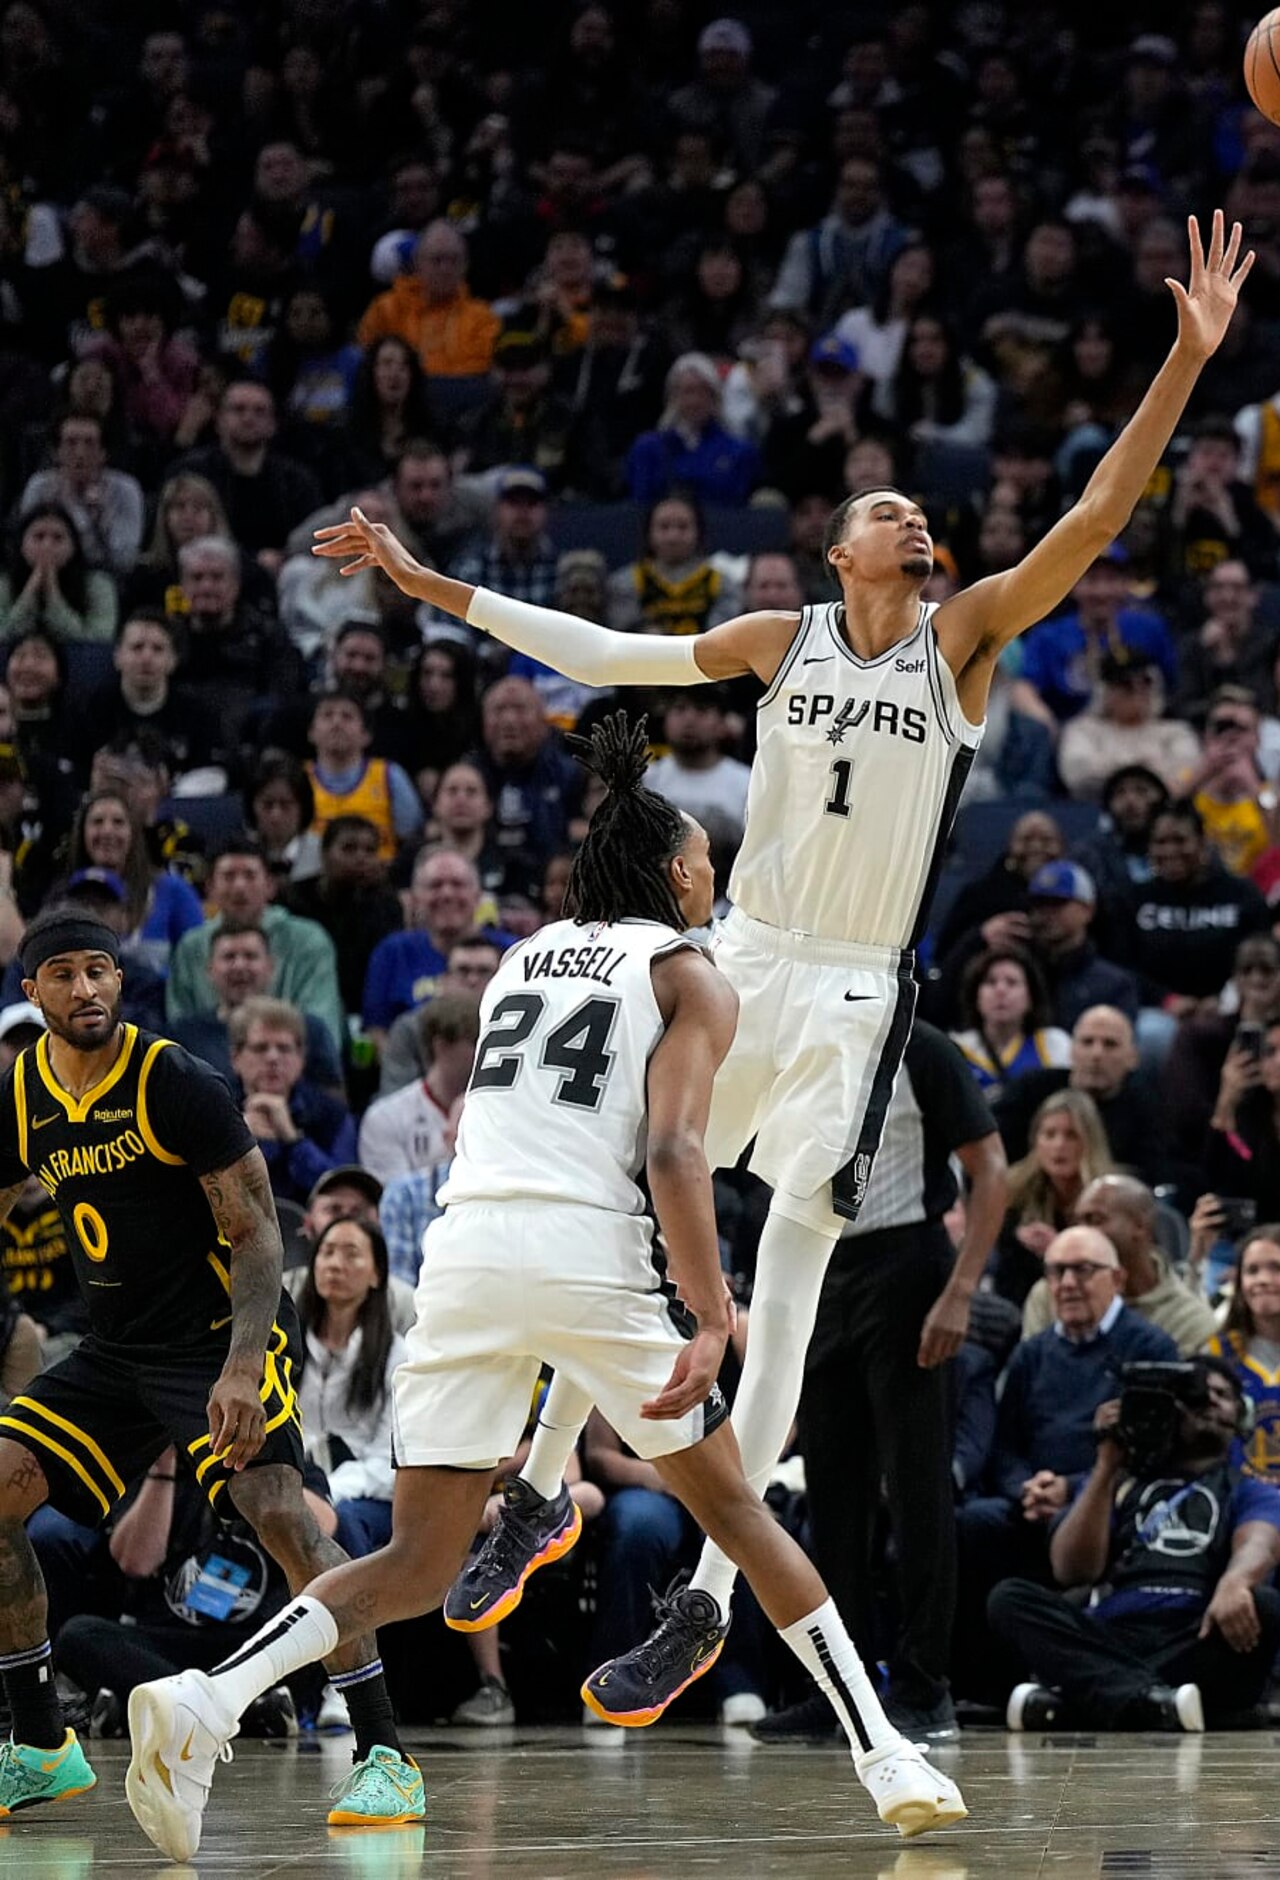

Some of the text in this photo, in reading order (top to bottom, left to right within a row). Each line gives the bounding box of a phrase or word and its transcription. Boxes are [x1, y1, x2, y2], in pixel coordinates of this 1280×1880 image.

[788, 695, 927, 746] SPURS
[824, 757, 855, 818] 1
[524, 947, 627, 987] VASSELL
[469, 991, 622, 1113] 24
[94, 1108, 133, 1121] Rakuten
[49, 1130, 144, 1181] FRANCISCO
[73, 1202, 108, 1262] 0
